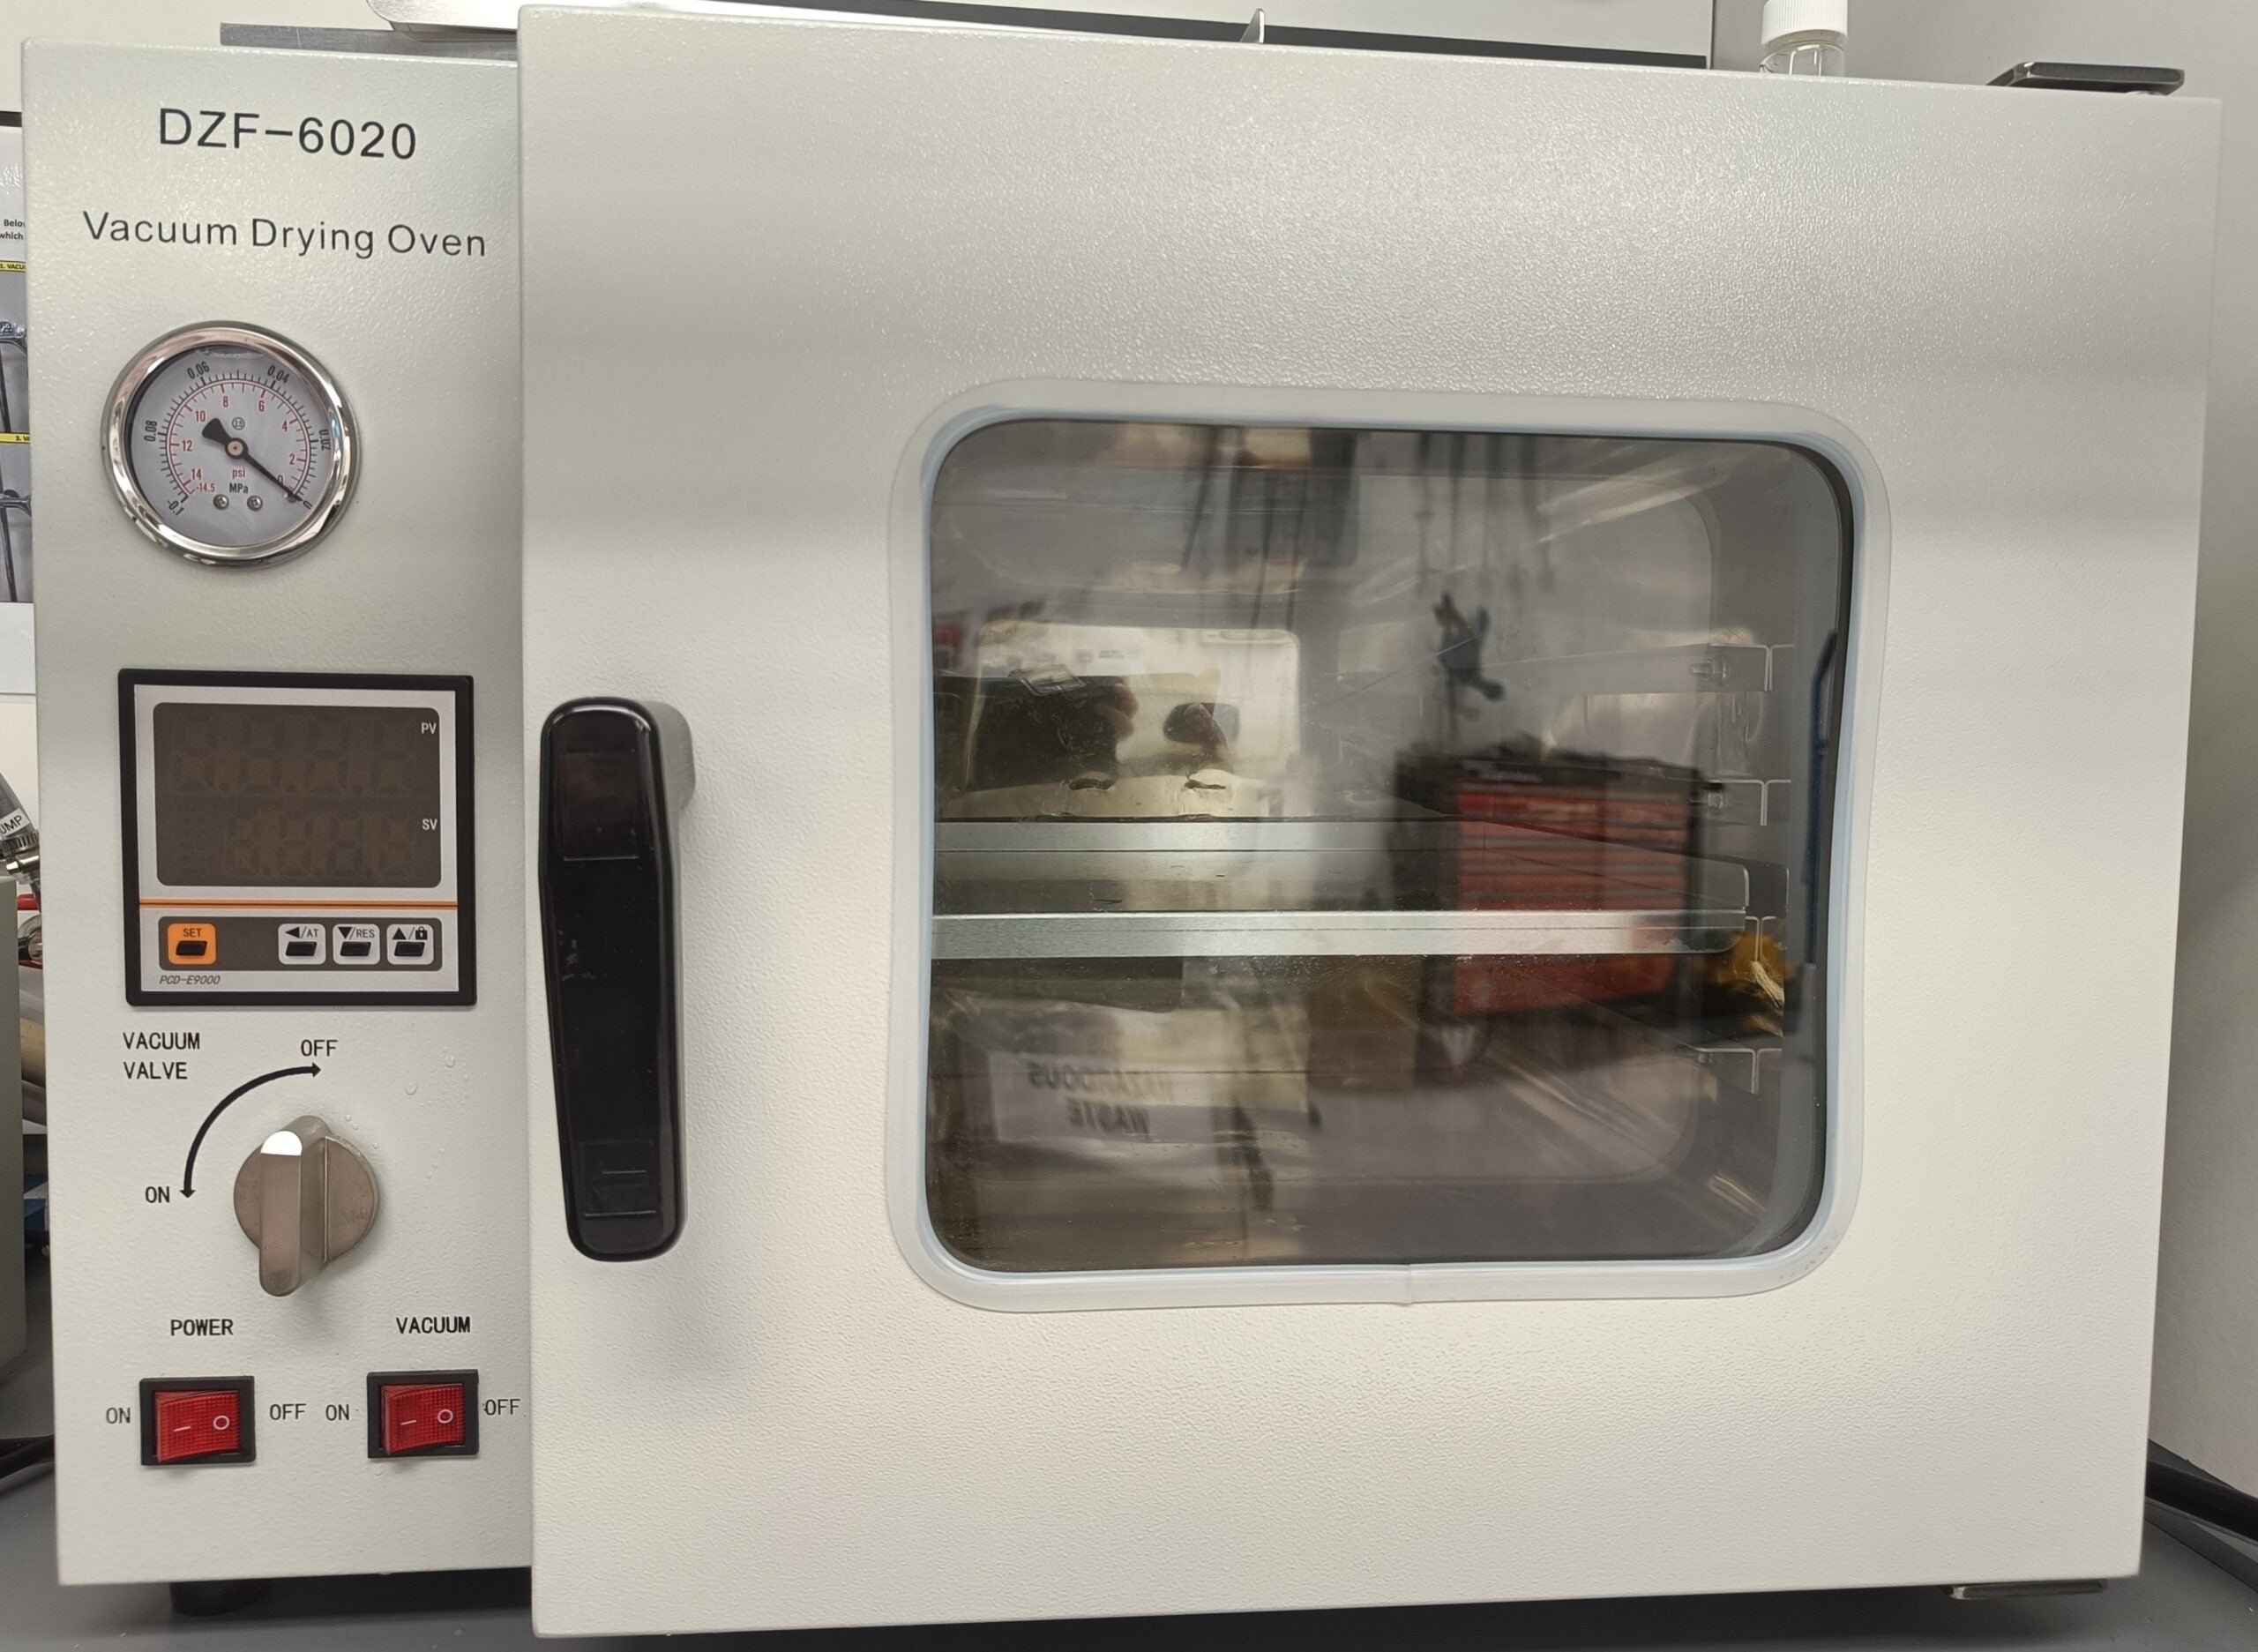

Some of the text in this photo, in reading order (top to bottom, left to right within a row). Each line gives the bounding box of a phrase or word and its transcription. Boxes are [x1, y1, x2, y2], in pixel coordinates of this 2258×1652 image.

[159, 108, 417, 160] DZF-6020
[0, 231, 24, 240] which
[83, 211, 487, 259] Vacuum Drying Oven
[187, 361, 210, 379] 0.06
[267, 365, 289, 384] 0.04
[222, 396, 228, 408] 8
[258, 400, 265, 412] 6
[195, 410, 206, 422] 10
[144, 421, 157, 442] 0.08
[281, 420, 288, 432] 4
[183, 440, 192, 452] 12
[289, 453, 295, 466] 2
[191, 468, 201, 480] 14
[232, 468, 246, 479] psi
[196, 483, 215, 493] -14.5
[229, 484, 249, 494] MPa
[167, 499, 184, 515] -0.1
[421, 721, 437, 734] PV
[422, 818, 437, 830] SV
[183, 927, 202, 938] SET
[123, 1032, 201, 1050] VACUUM
[301, 1039, 338, 1057] OFF
[123, 1061, 188, 1080] VALVE
[145, 1185, 170, 1203] ON
[170, 1319, 234, 1336] POWER
[396, 1316, 471, 1334] VACUUM
[106, 1408, 131, 1424] ON
[269, 1403, 307, 1421] OFF
[325, 1404, 350, 1422] ON
[485, 1399, 520, 1417] OFF
